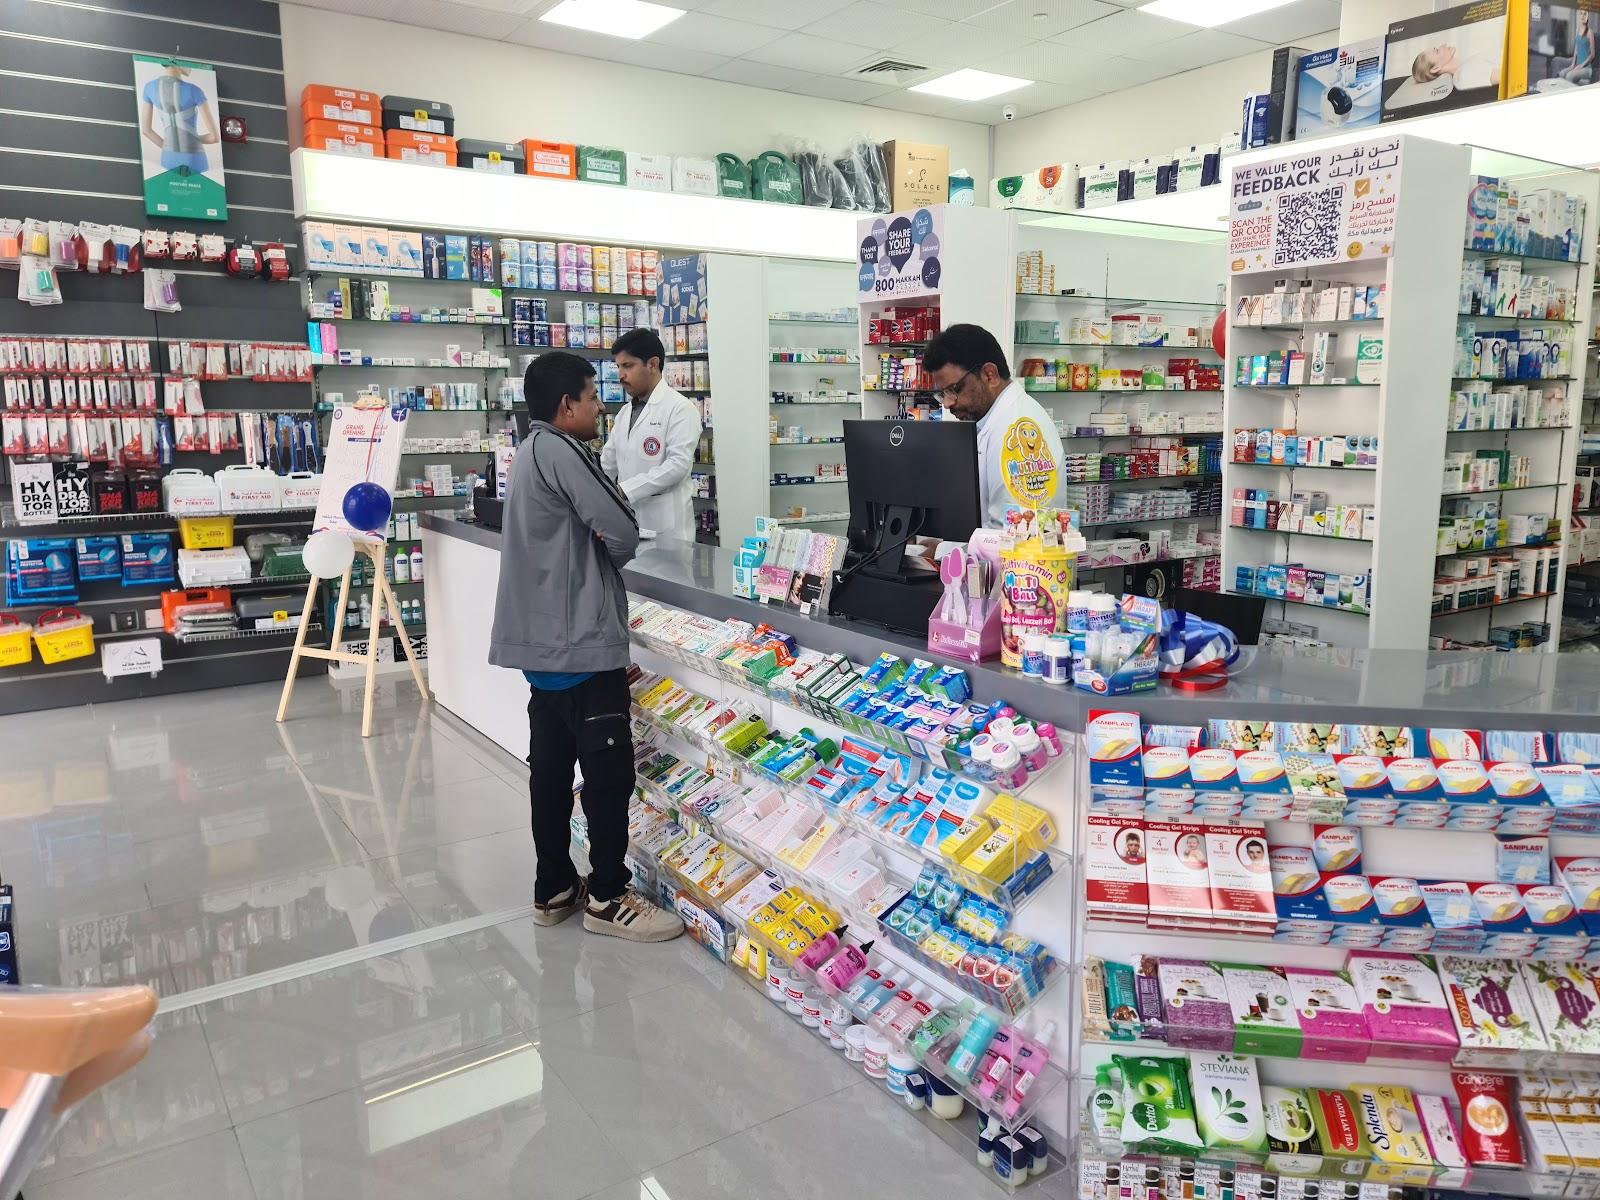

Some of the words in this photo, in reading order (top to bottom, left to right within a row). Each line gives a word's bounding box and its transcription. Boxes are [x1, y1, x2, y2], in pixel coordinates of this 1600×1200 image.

[1368, 140, 1399, 158] نحن
[1329, 148, 1365, 166] نقدر
[1236, 170, 1250, 180] WE
[1255, 163, 1287, 177] VALUE
[1291, 156, 1321, 170] YOUR
[1369, 155, 1398, 171] لك
[1329, 163, 1364, 178] رأيك
[904, 182, 940, 191] SOLACE
[1234, 169, 1320, 198] FEEDBACK
[1349, 201, 1365, 212] رمز
[1367, 193, 1395, 211] امسح
[1232, 217, 1255, 229] SCAN
[1257, 215, 1272, 225] THE
[888, 228, 911, 240] SHARE
[1231, 228, 1244, 238] QR
[1246, 224, 1272, 235] CODE
[862, 245, 877, 254] THANK
[889, 239, 911, 249] YOUR
[864, 252, 874, 260] YOU
[671, 257, 690, 268] QUEST
[875, 278, 894, 292] 800
[896, 274, 921, 284] MAKKAH
[891, 432, 904, 440] DELL
[1008, 459, 1035, 476] MULTI
[1037, 458, 1055, 472] BALL
[20, 481, 50, 494] HY
[56, 477, 88, 492] HY
[22, 494, 52, 503] DRA
[58, 490, 89, 500] DRA
[22, 501, 53, 511] TOR
[59, 499, 90, 509] TOR
[1005, 571, 1038, 588] MULTI
[1012, 588, 1038, 602] BALL
[1088, 612, 1116, 622] mentos
[1134, 661, 1156, 669] THERAPY
[1095, 720, 1134, 728] SANIPLAST
[1088, 817, 1110, 826] Cooling
[1149, 823, 1171, 832] Cooling
[1209, 826, 1232, 835] Cooling
[1243, 828, 1261, 836] Strips
[1156, 839, 1162, 847] 4
[1503, 844, 1543, 852] SANIPLAST
[1269, 854, 1309, 862] SANIPLAST
[1424, 887, 1464, 895] SANIPLAST
[1455, 988, 1473, 1027] ROYAL
[1200, 1063, 1249, 1075] STEVIANA
[1457, 1074, 1504, 1087] Canderel
[1147, 1103, 1158, 1131] Dettol
[1360, 1094, 1390, 1150] Splenda
